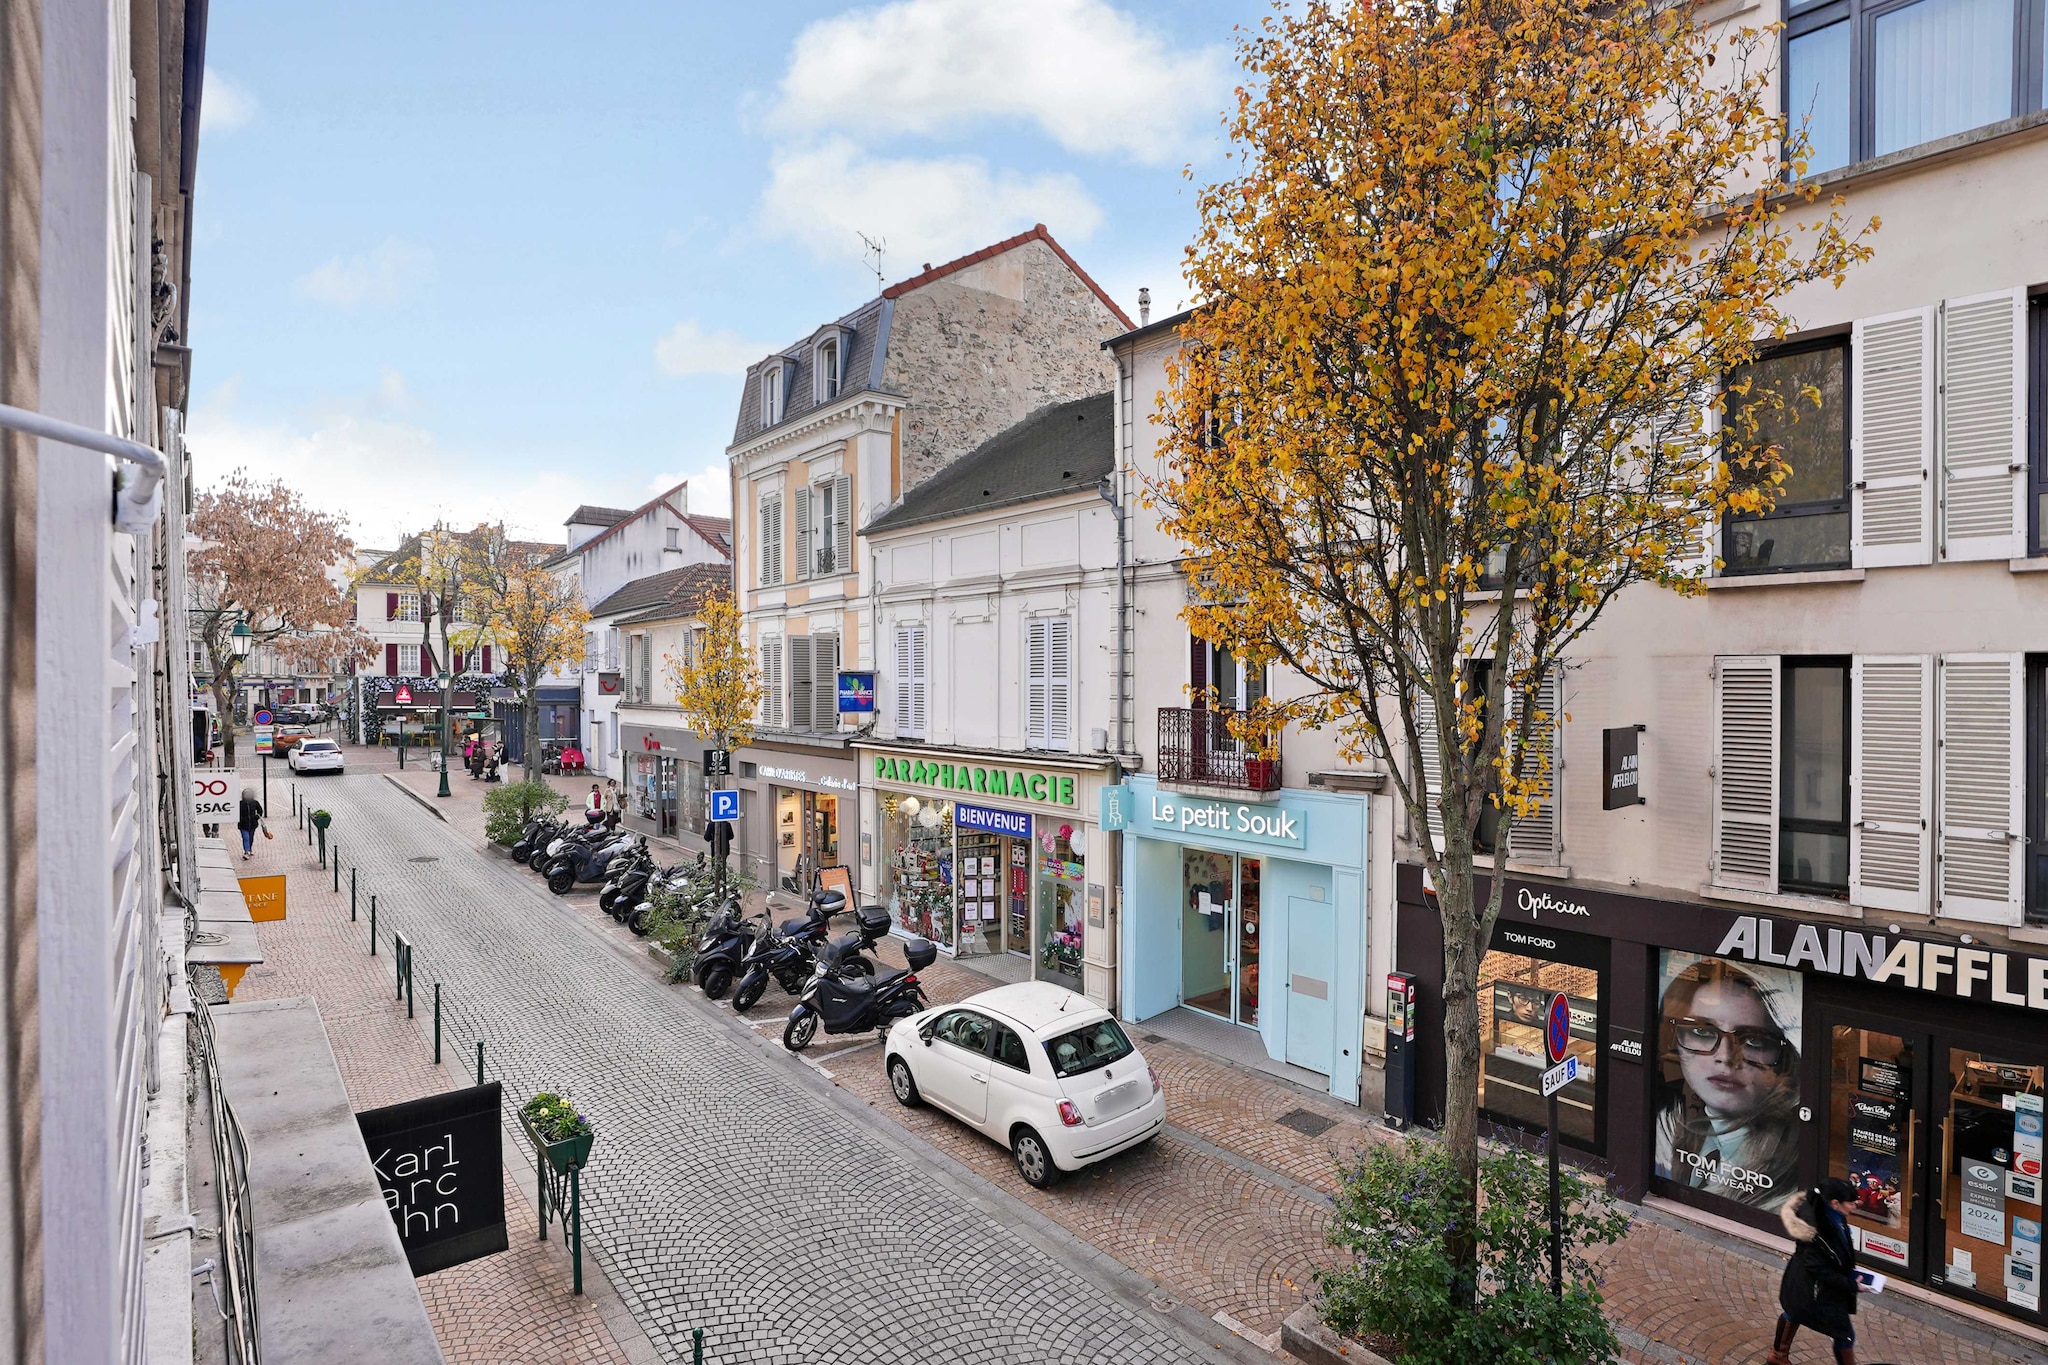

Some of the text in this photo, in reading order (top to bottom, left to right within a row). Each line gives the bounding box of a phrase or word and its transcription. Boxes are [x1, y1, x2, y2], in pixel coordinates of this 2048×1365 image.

[1620, 754, 1639, 771] ALAIN
[875, 757, 1074, 804] PARAPHARMACIE
[1611, 770, 1639, 789] AFFLELOU
[718, 796, 732, 815] P
[959, 807, 1026, 833] BIENVENUE
[1152, 796, 1298, 840] Le petit Souk
[1517, 887, 1591, 919] Opticien
[1504, 931, 1556, 950] TOM FORD
[1714, 915, 1886, 980] ALAIN
[1408, 985, 1415, 1003] P
[1610, 1043, 1642, 1057] AFFLELOU
[1621, 1039, 1642, 1050] ALAIN
[1544, 1067, 1566, 1091] SAUF
[1676, 1149, 1774, 1189] TOM FORD
[1695, 1168, 1755, 1195] EYEWEAR
[1967, 1180, 1999, 1193] essilor
[1970, 1192, 1996, 1204] EXPERTS
[1967, 1207, 1998, 1223] 2024
